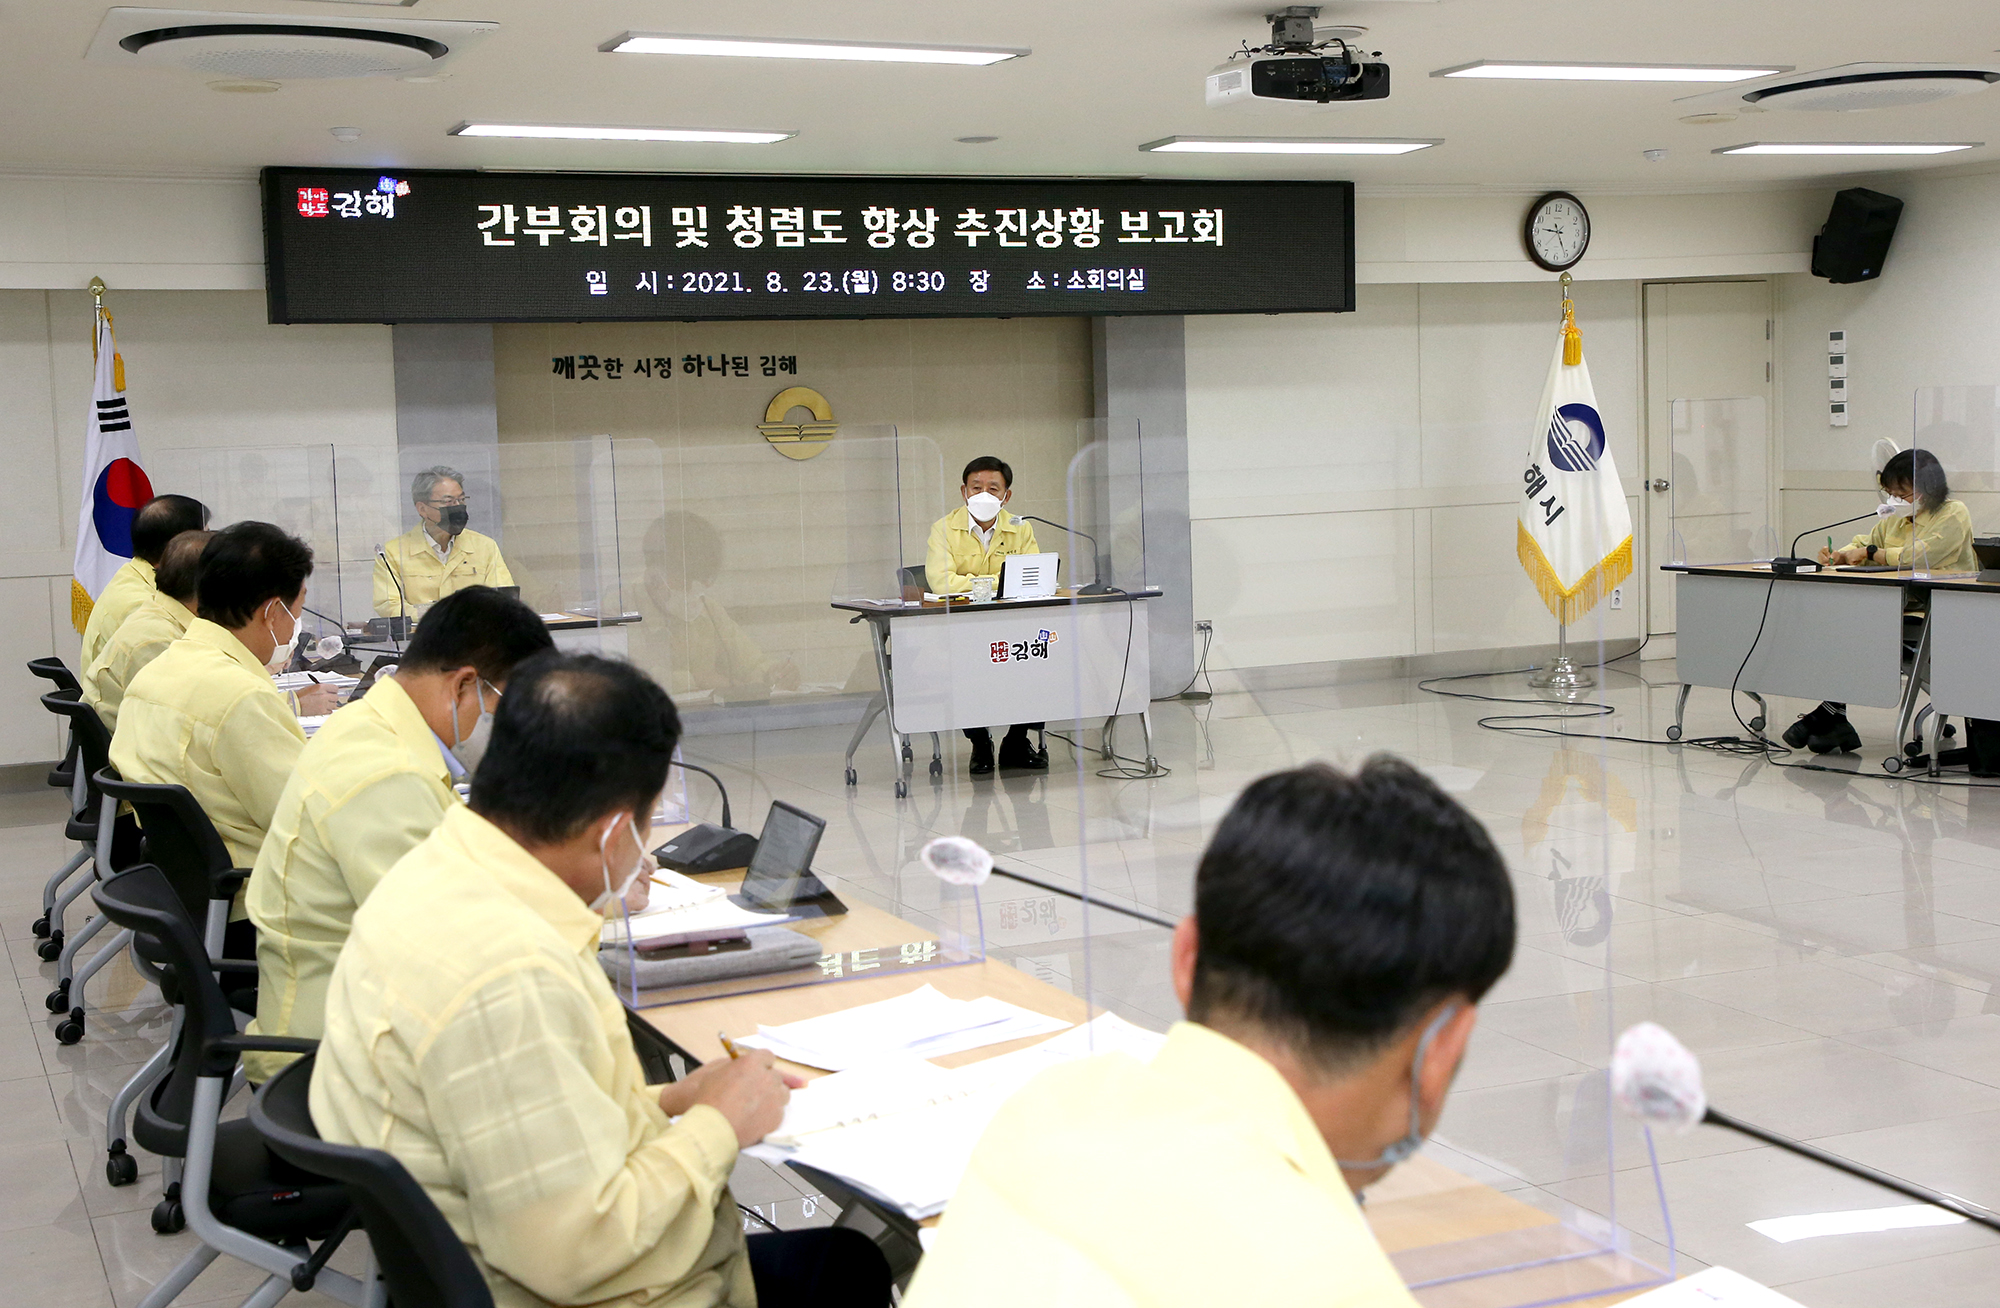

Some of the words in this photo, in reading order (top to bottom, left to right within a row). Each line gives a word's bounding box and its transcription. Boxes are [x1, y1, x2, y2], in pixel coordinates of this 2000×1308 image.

[331, 189, 395, 218] 김해
[477, 203, 652, 247] 간부회의
[671, 205, 710, 249] 및
[725, 204, 848, 249] 청렴도
[860, 205, 940, 249] 향상
[953, 206, 1105, 249] 추진상황
[1117, 208, 1224, 247] 보고회
[892, 270, 945, 293] 8:30
[552, 355, 624, 381] 깨끗한
[633, 357, 672, 379] 시정
[682, 353, 749, 378] 하나된
[760, 355, 797, 377] 김해
[1011, 639, 1048, 661] 김해
